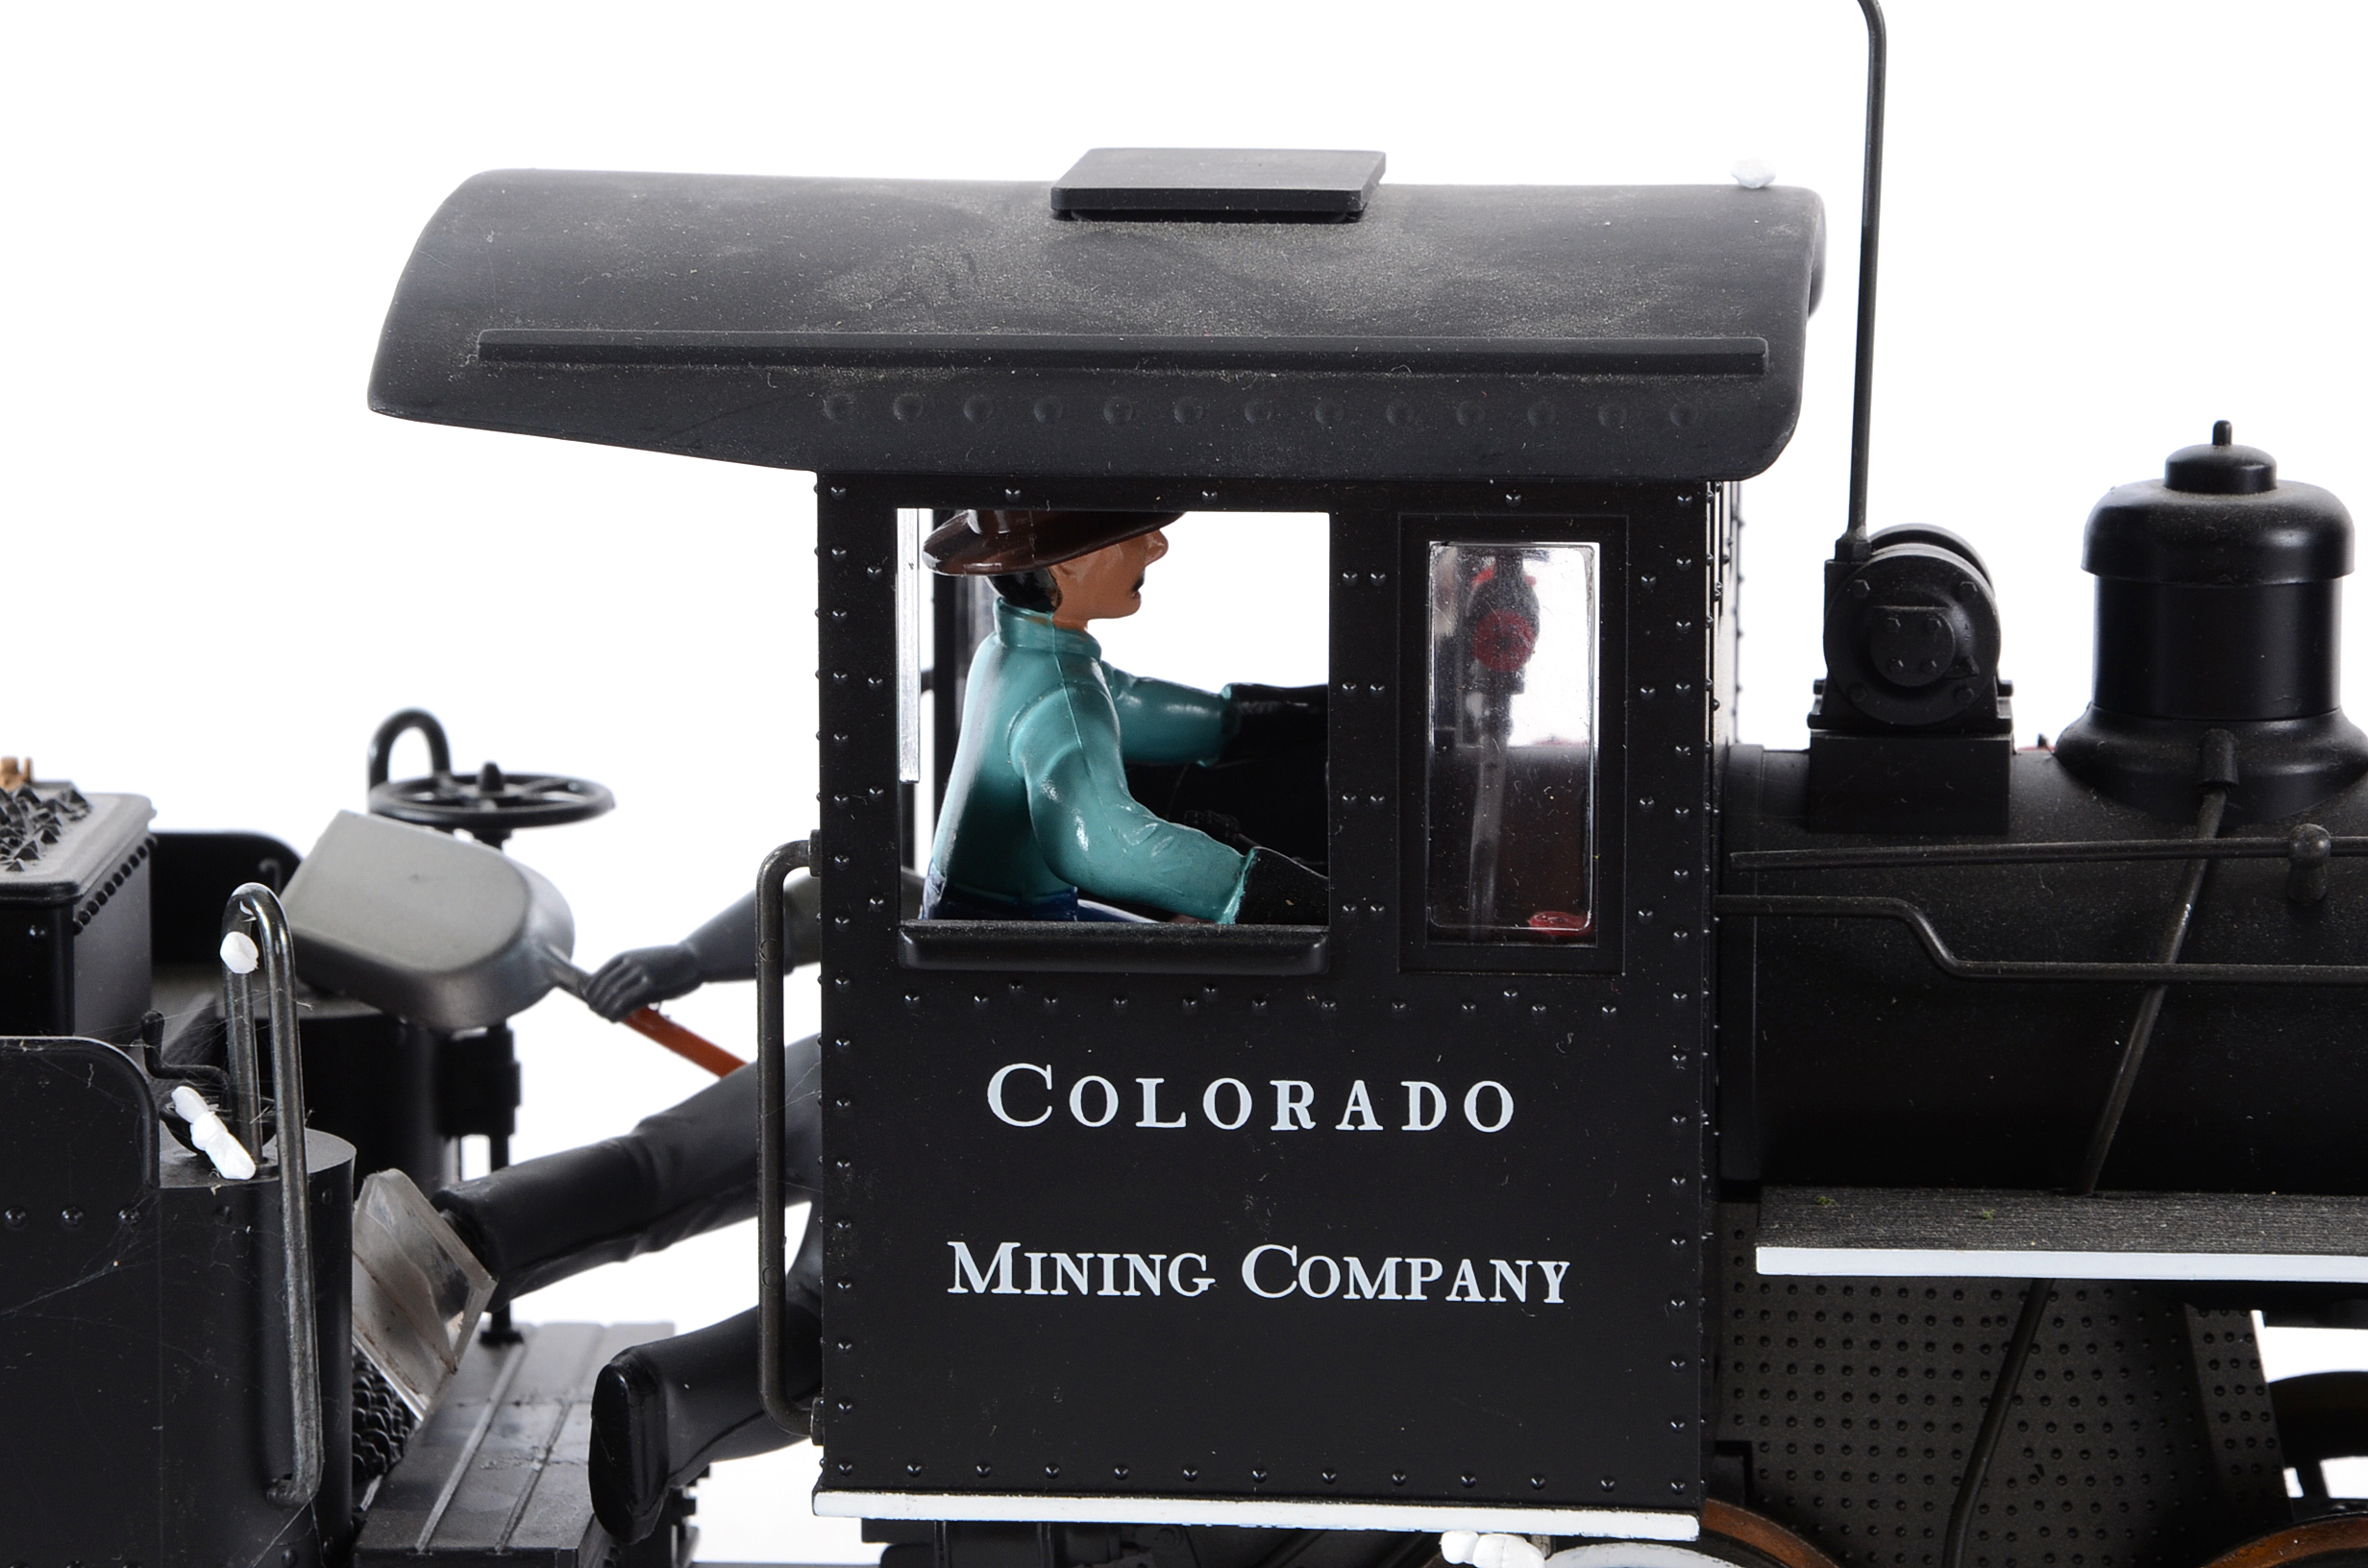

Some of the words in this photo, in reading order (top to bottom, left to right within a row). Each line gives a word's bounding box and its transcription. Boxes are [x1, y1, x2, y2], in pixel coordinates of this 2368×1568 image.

[987, 1063, 1515, 1133] COLORADO
[947, 1240, 1216, 1297] MINING
[1241, 1243, 1571, 1304] COMPANY
